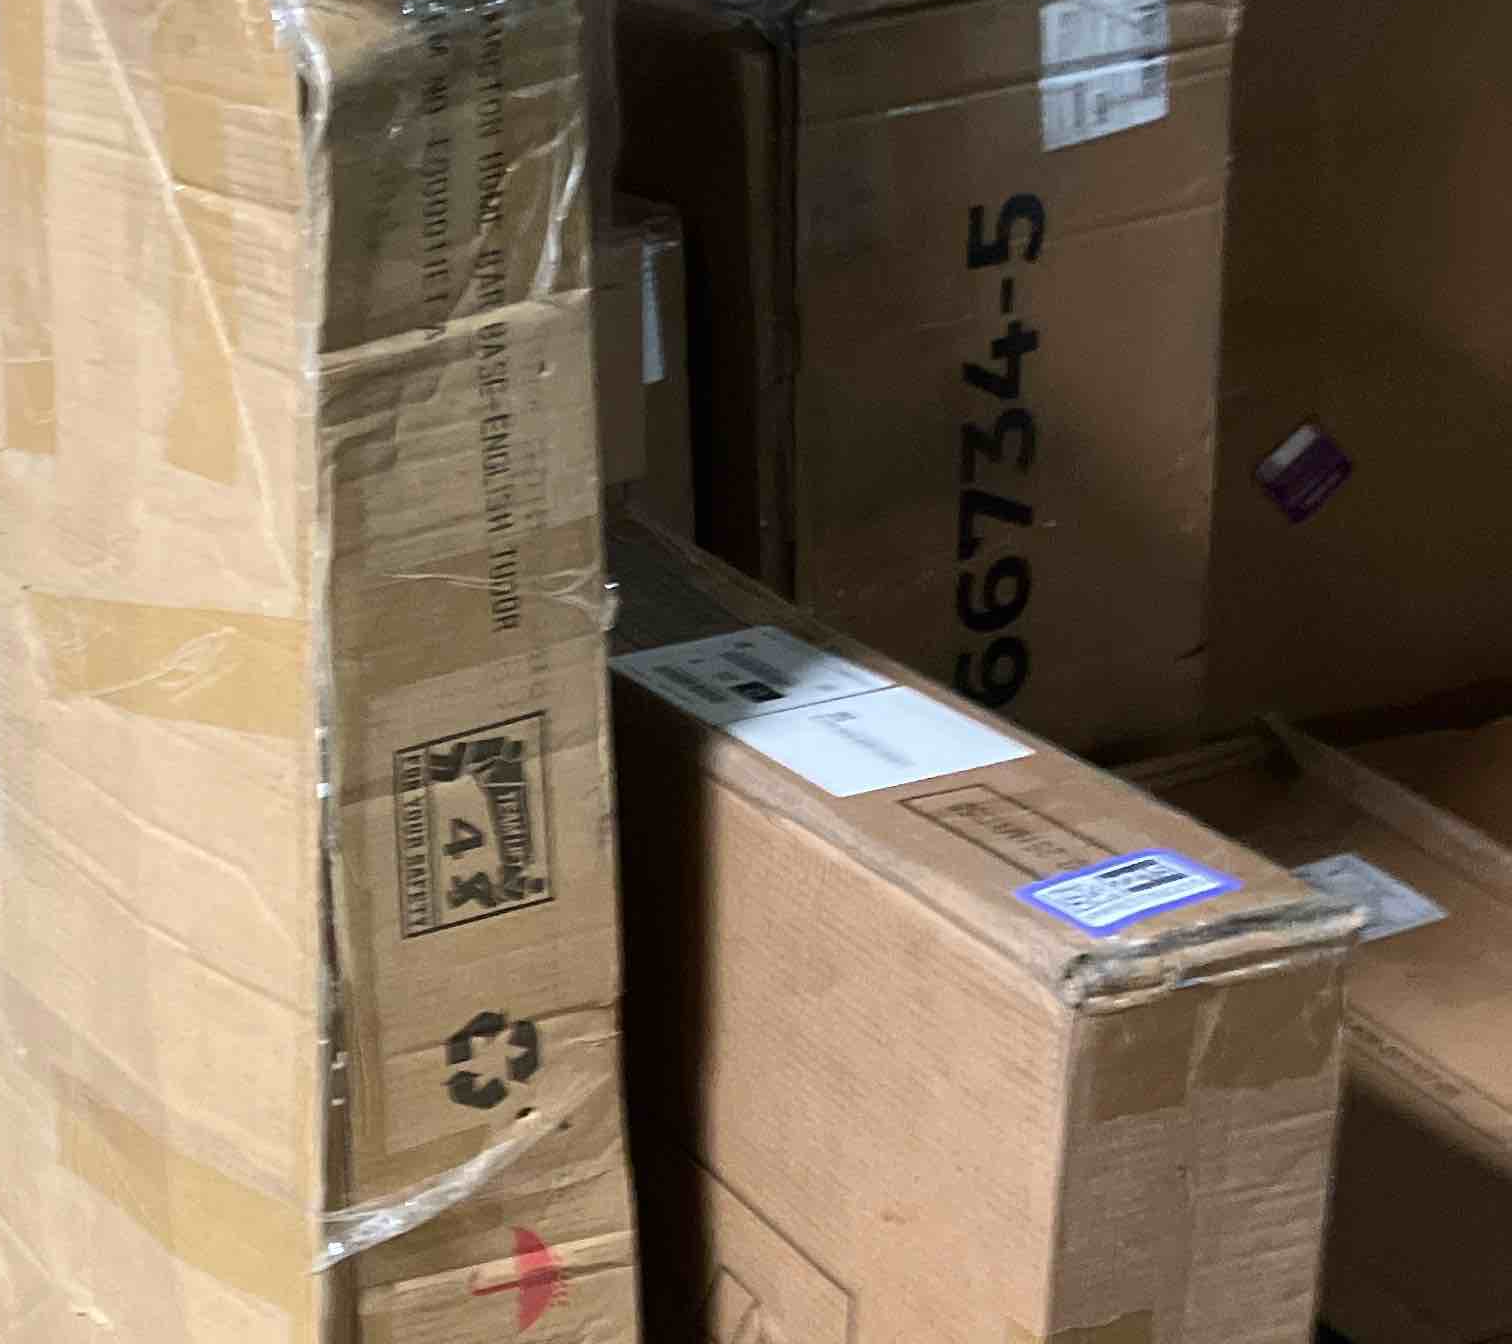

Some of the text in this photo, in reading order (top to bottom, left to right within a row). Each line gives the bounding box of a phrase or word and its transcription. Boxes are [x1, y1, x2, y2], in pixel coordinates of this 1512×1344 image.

[954, 192, 1046, 710] 66734-5
[404, 755, 429, 927] FOR YOUR SAFETY
[496, 792, 523, 836] TEAM
